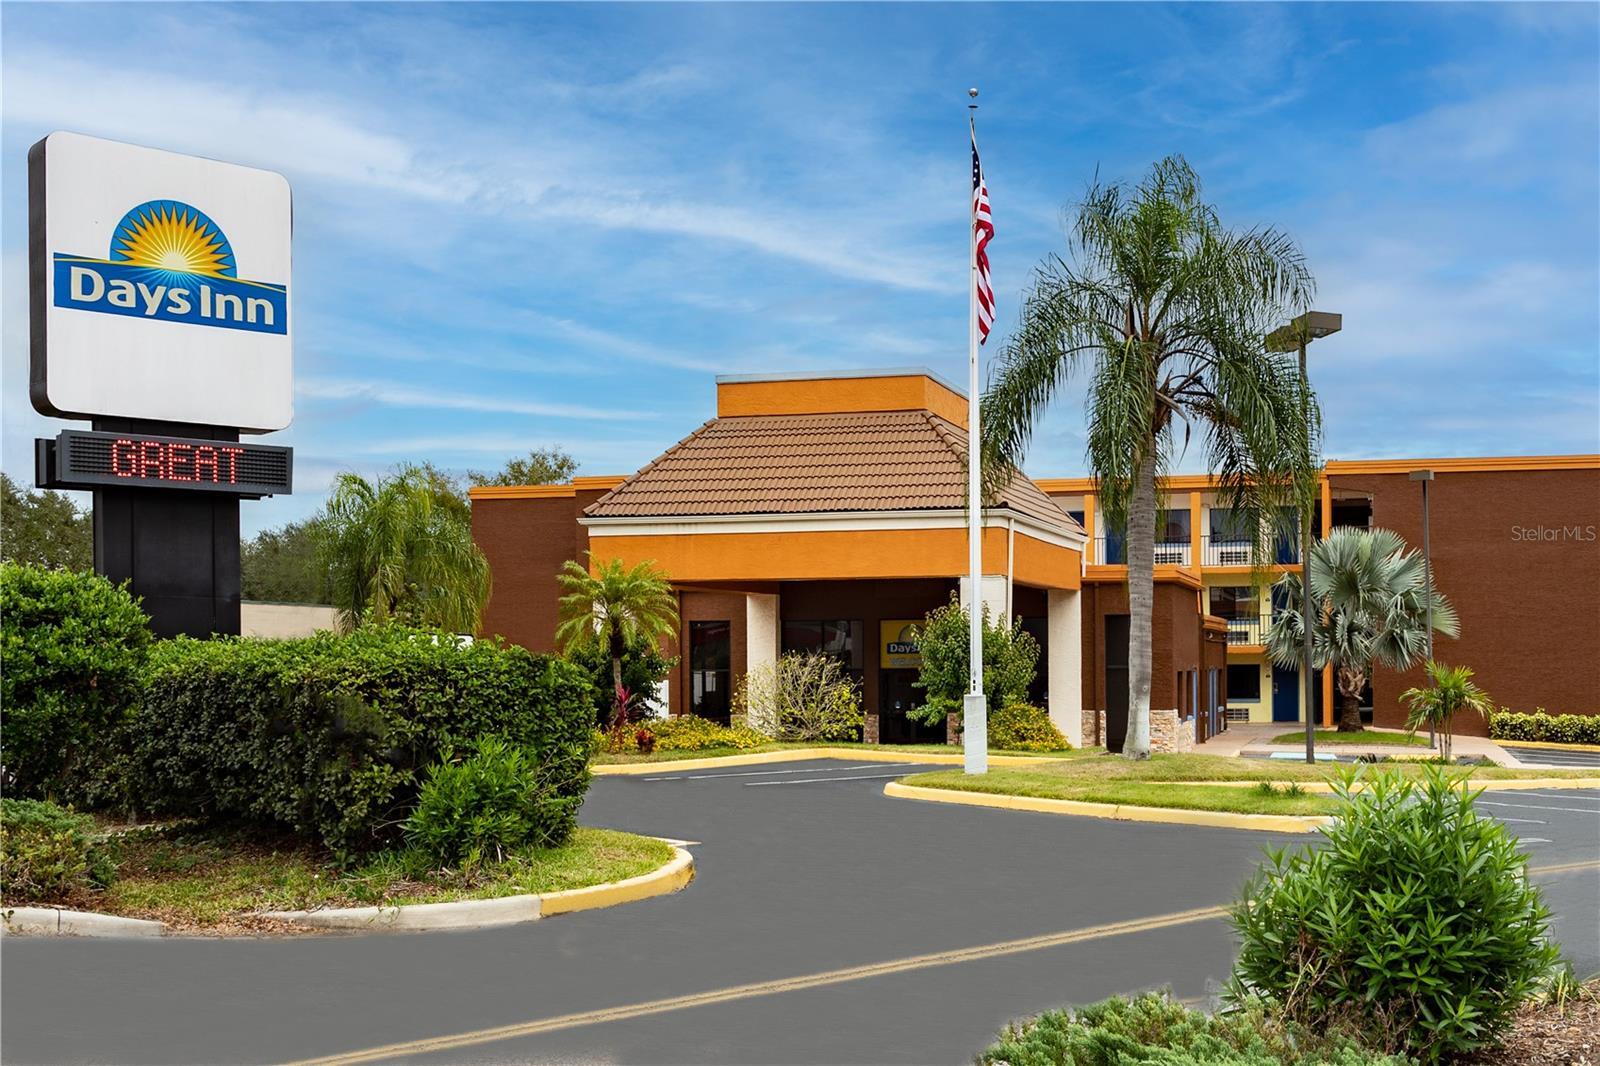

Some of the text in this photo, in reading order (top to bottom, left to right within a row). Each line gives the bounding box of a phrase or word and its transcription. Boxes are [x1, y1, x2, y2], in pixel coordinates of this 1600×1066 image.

[70, 265, 274, 326] Days Inn
[111, 438, 245, 485] GREAT
[889, 643, 917, 654] Days
